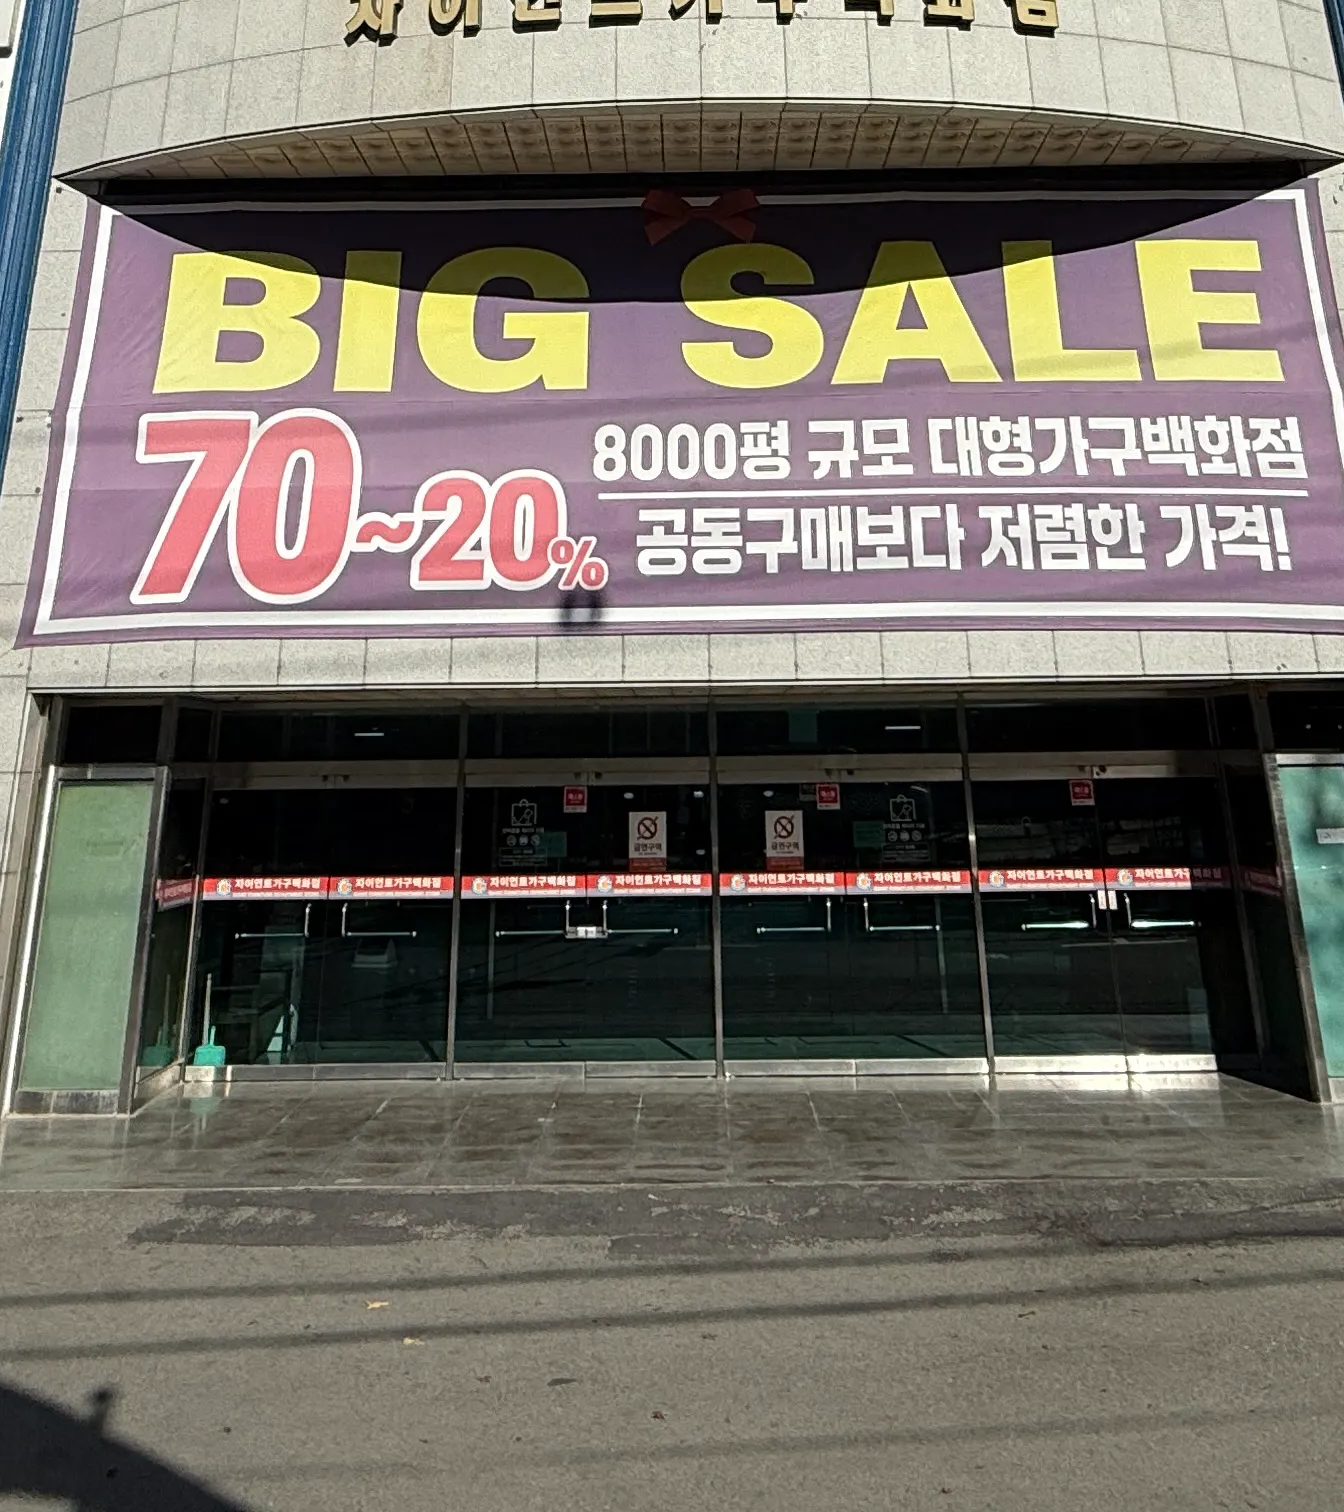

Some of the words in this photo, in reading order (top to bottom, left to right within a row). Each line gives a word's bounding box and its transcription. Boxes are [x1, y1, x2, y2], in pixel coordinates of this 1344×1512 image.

[152, 247, 591, 394] BIG
[679, 239, 1286, 391] SALE
[593, 420, 790, 482] 8000평
[807, 418, 915, 479] 규모
[929, 414, 1309, 481] 대형가구백화점
[636, 505, 967, 576] 공동구매보다
[978, 503, 1146, 572] 저렴한
[1161, 504, 1293, 573] 가격!
